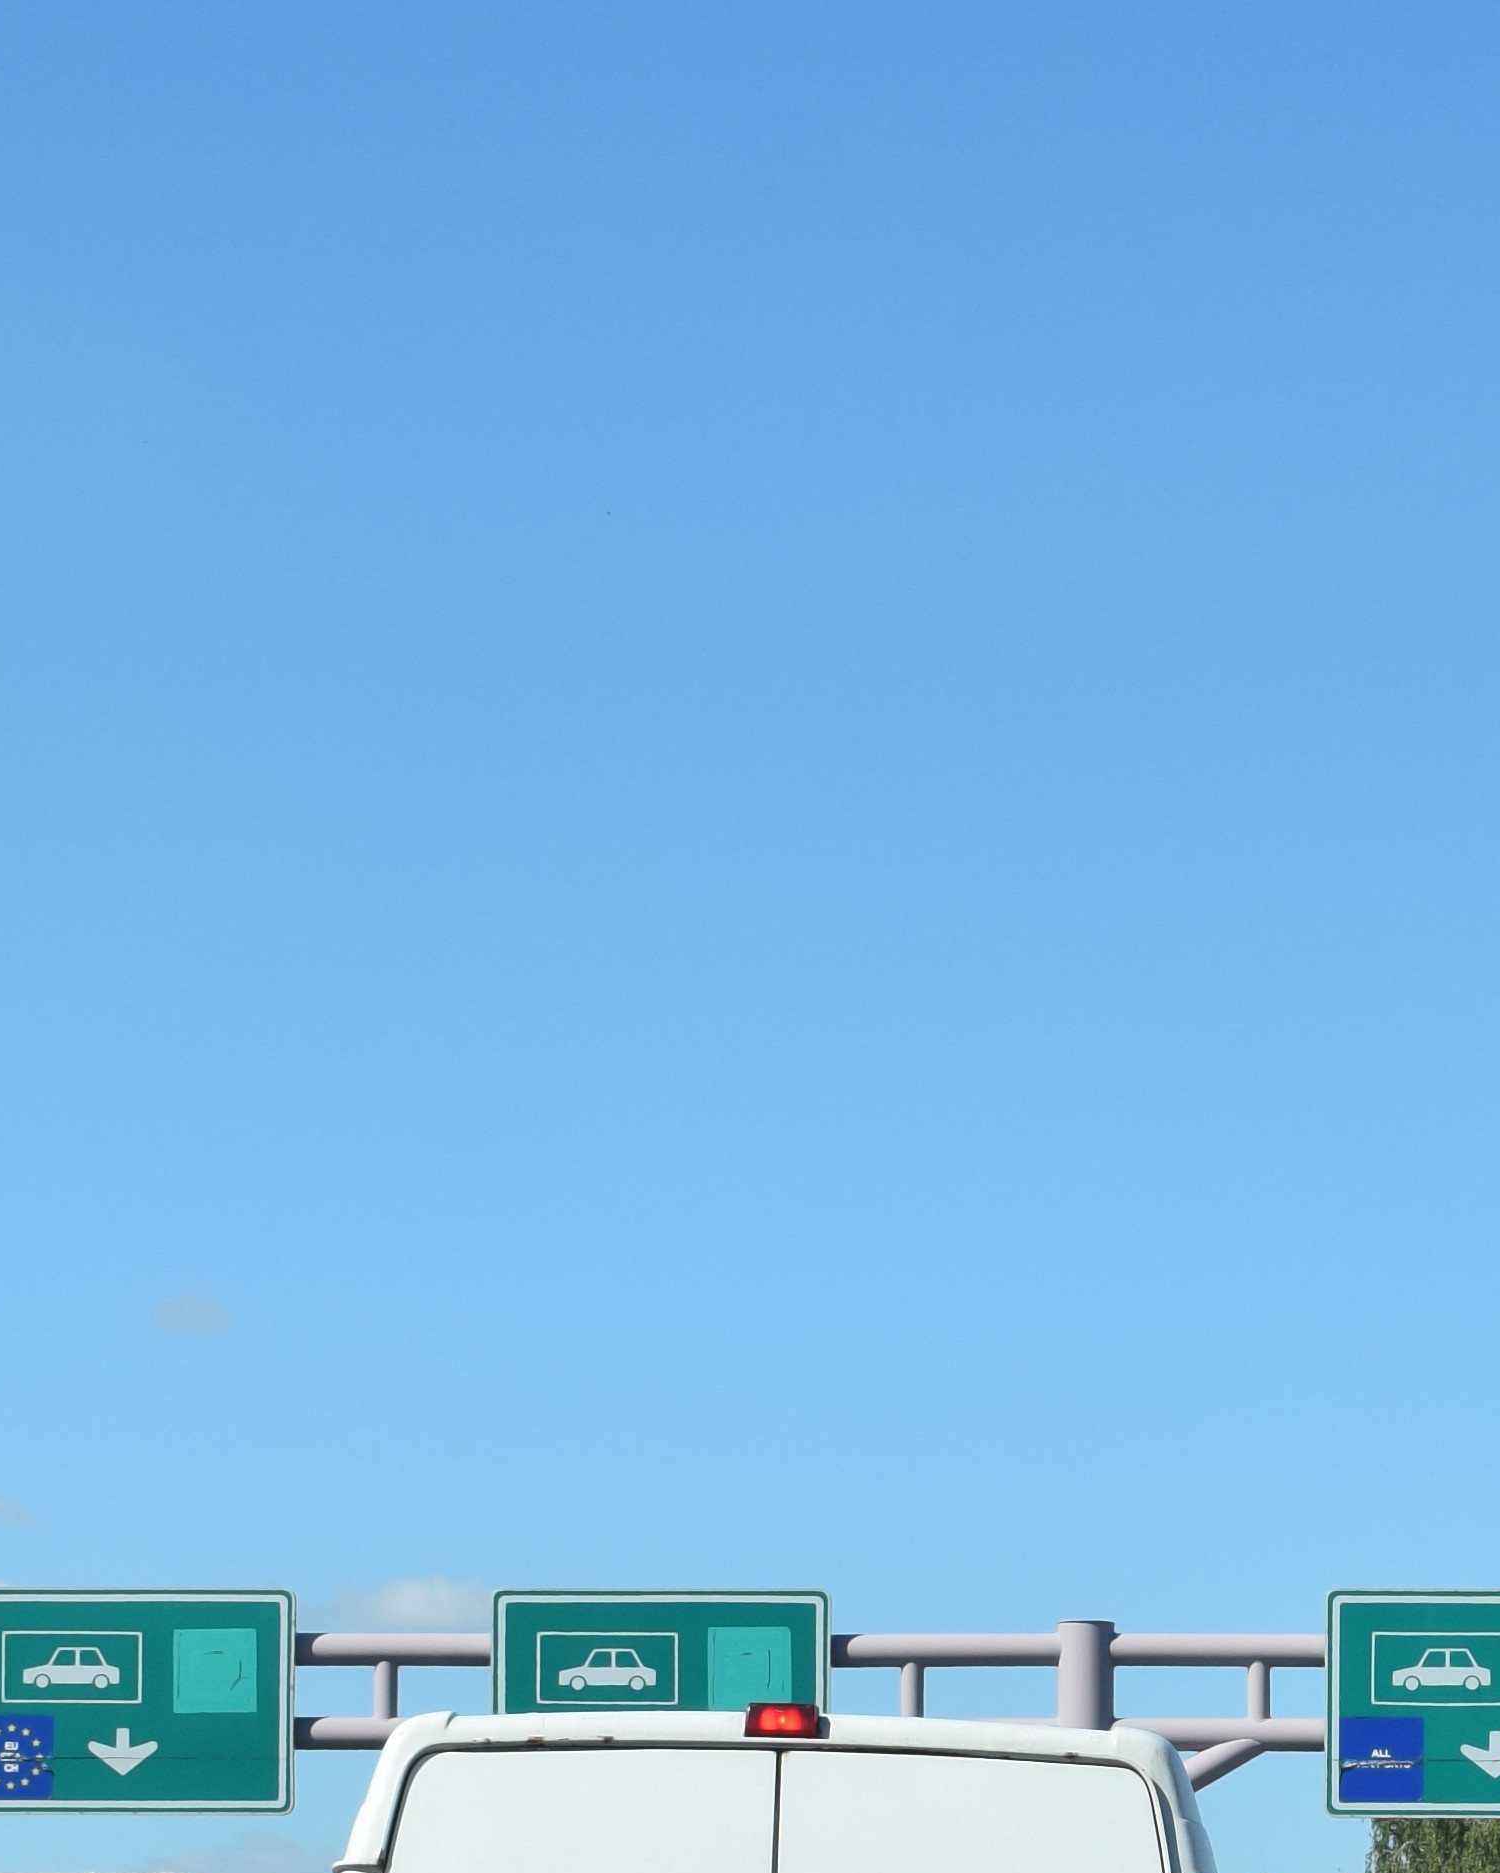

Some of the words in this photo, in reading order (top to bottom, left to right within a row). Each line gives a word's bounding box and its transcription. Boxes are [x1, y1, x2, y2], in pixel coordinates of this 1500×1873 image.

[4, 1741, 19, 1751] EU
[1371, 1748, 1392, 1758] ALL
[3, 1763, 19, 1773] CH
